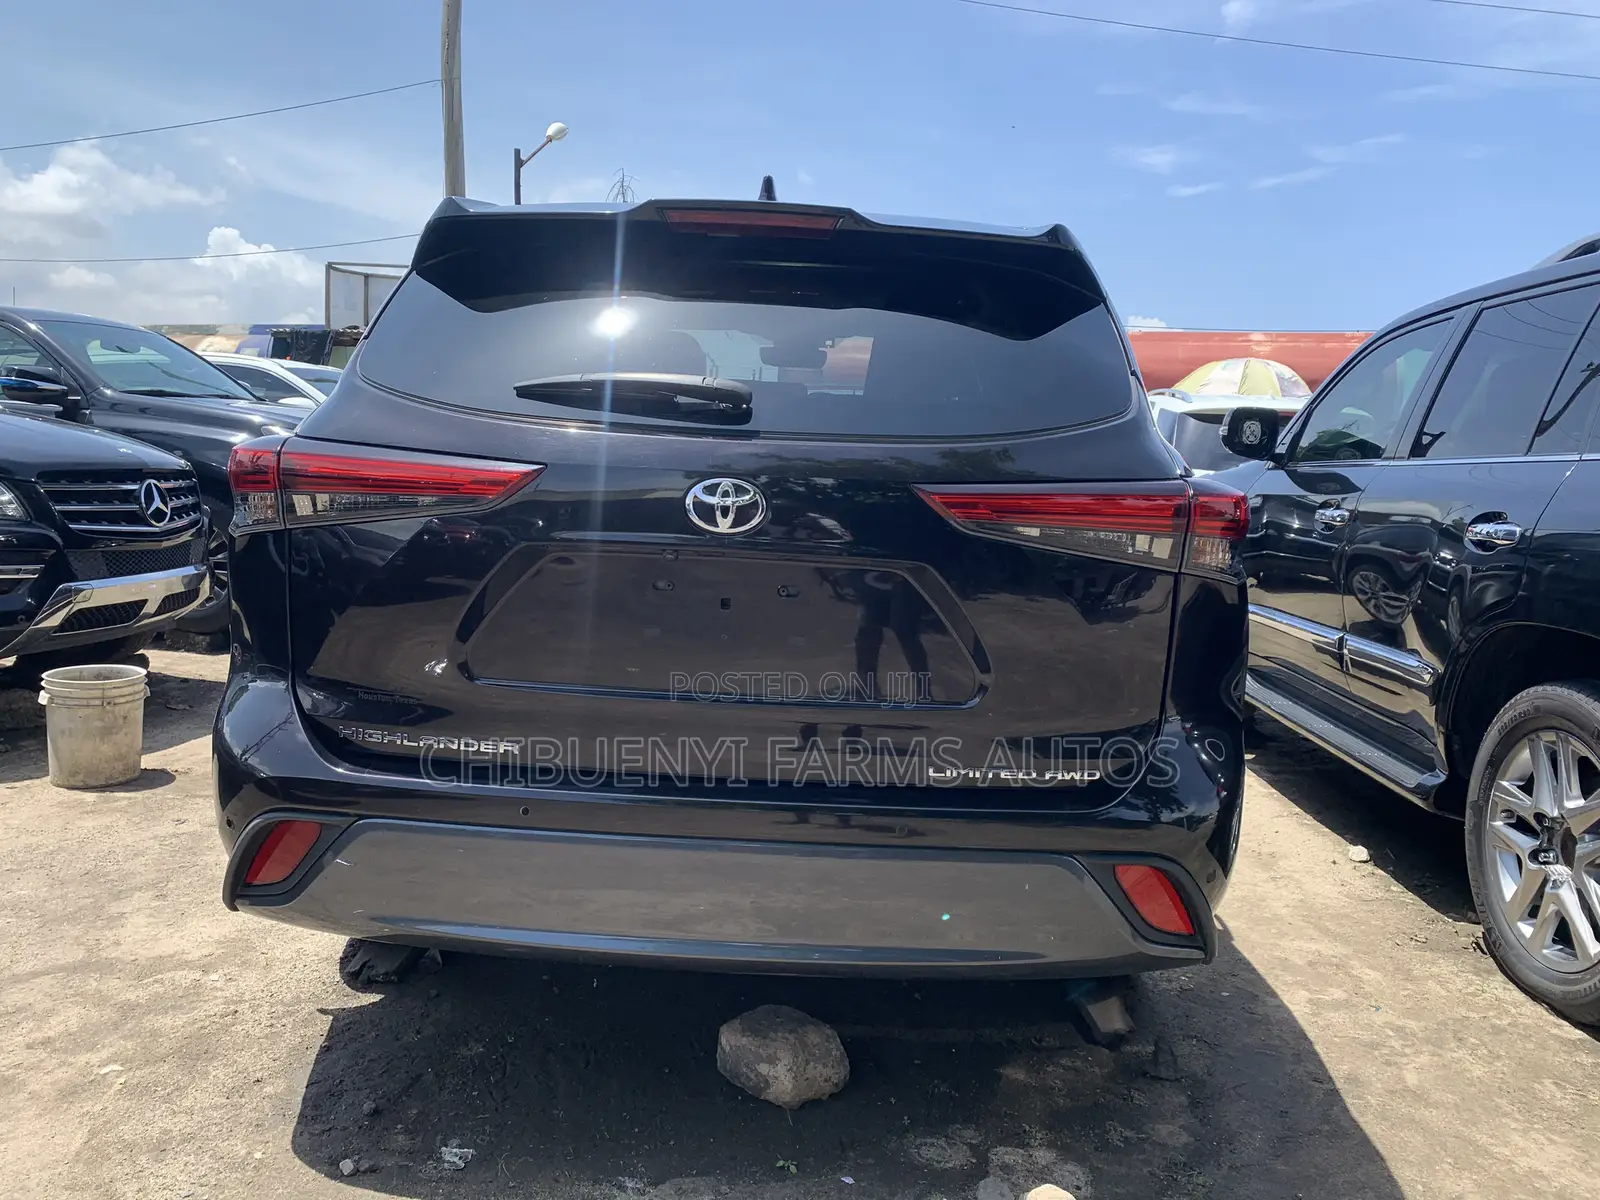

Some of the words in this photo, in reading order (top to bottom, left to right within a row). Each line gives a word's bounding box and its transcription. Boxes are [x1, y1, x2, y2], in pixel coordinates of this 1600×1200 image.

[338, 725, 520, 754] HIGHLANDER
[928, 766, 1037, 779] LIMITED
[1044, 770, 1101, 780] AWD
